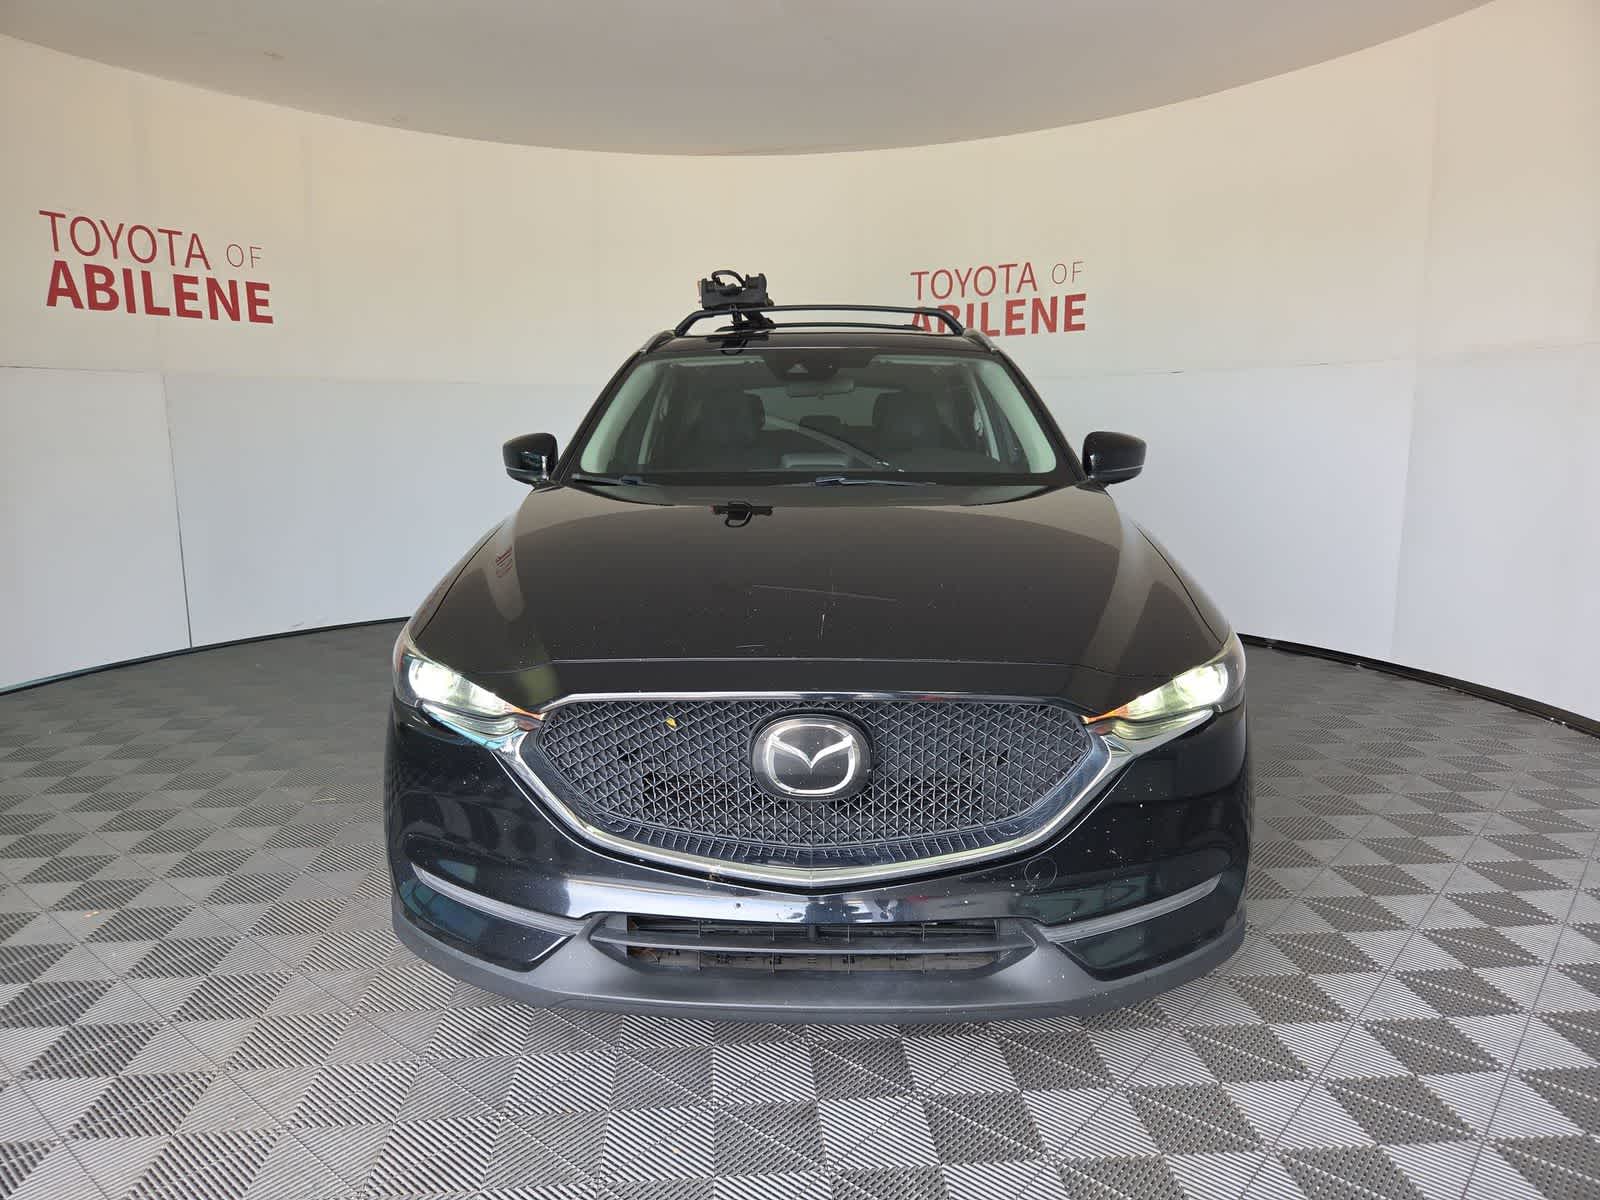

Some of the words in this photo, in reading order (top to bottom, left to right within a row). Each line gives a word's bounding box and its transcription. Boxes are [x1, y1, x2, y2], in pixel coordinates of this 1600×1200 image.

[39, 209, 211, 270] TOYOTA
[226, 243, 262, 269] OF
[46, 259, 274, 324] ABILENE
[910, 262, 1038, 301] TOYOTA
[1051, 260, 1084, 285] OF
